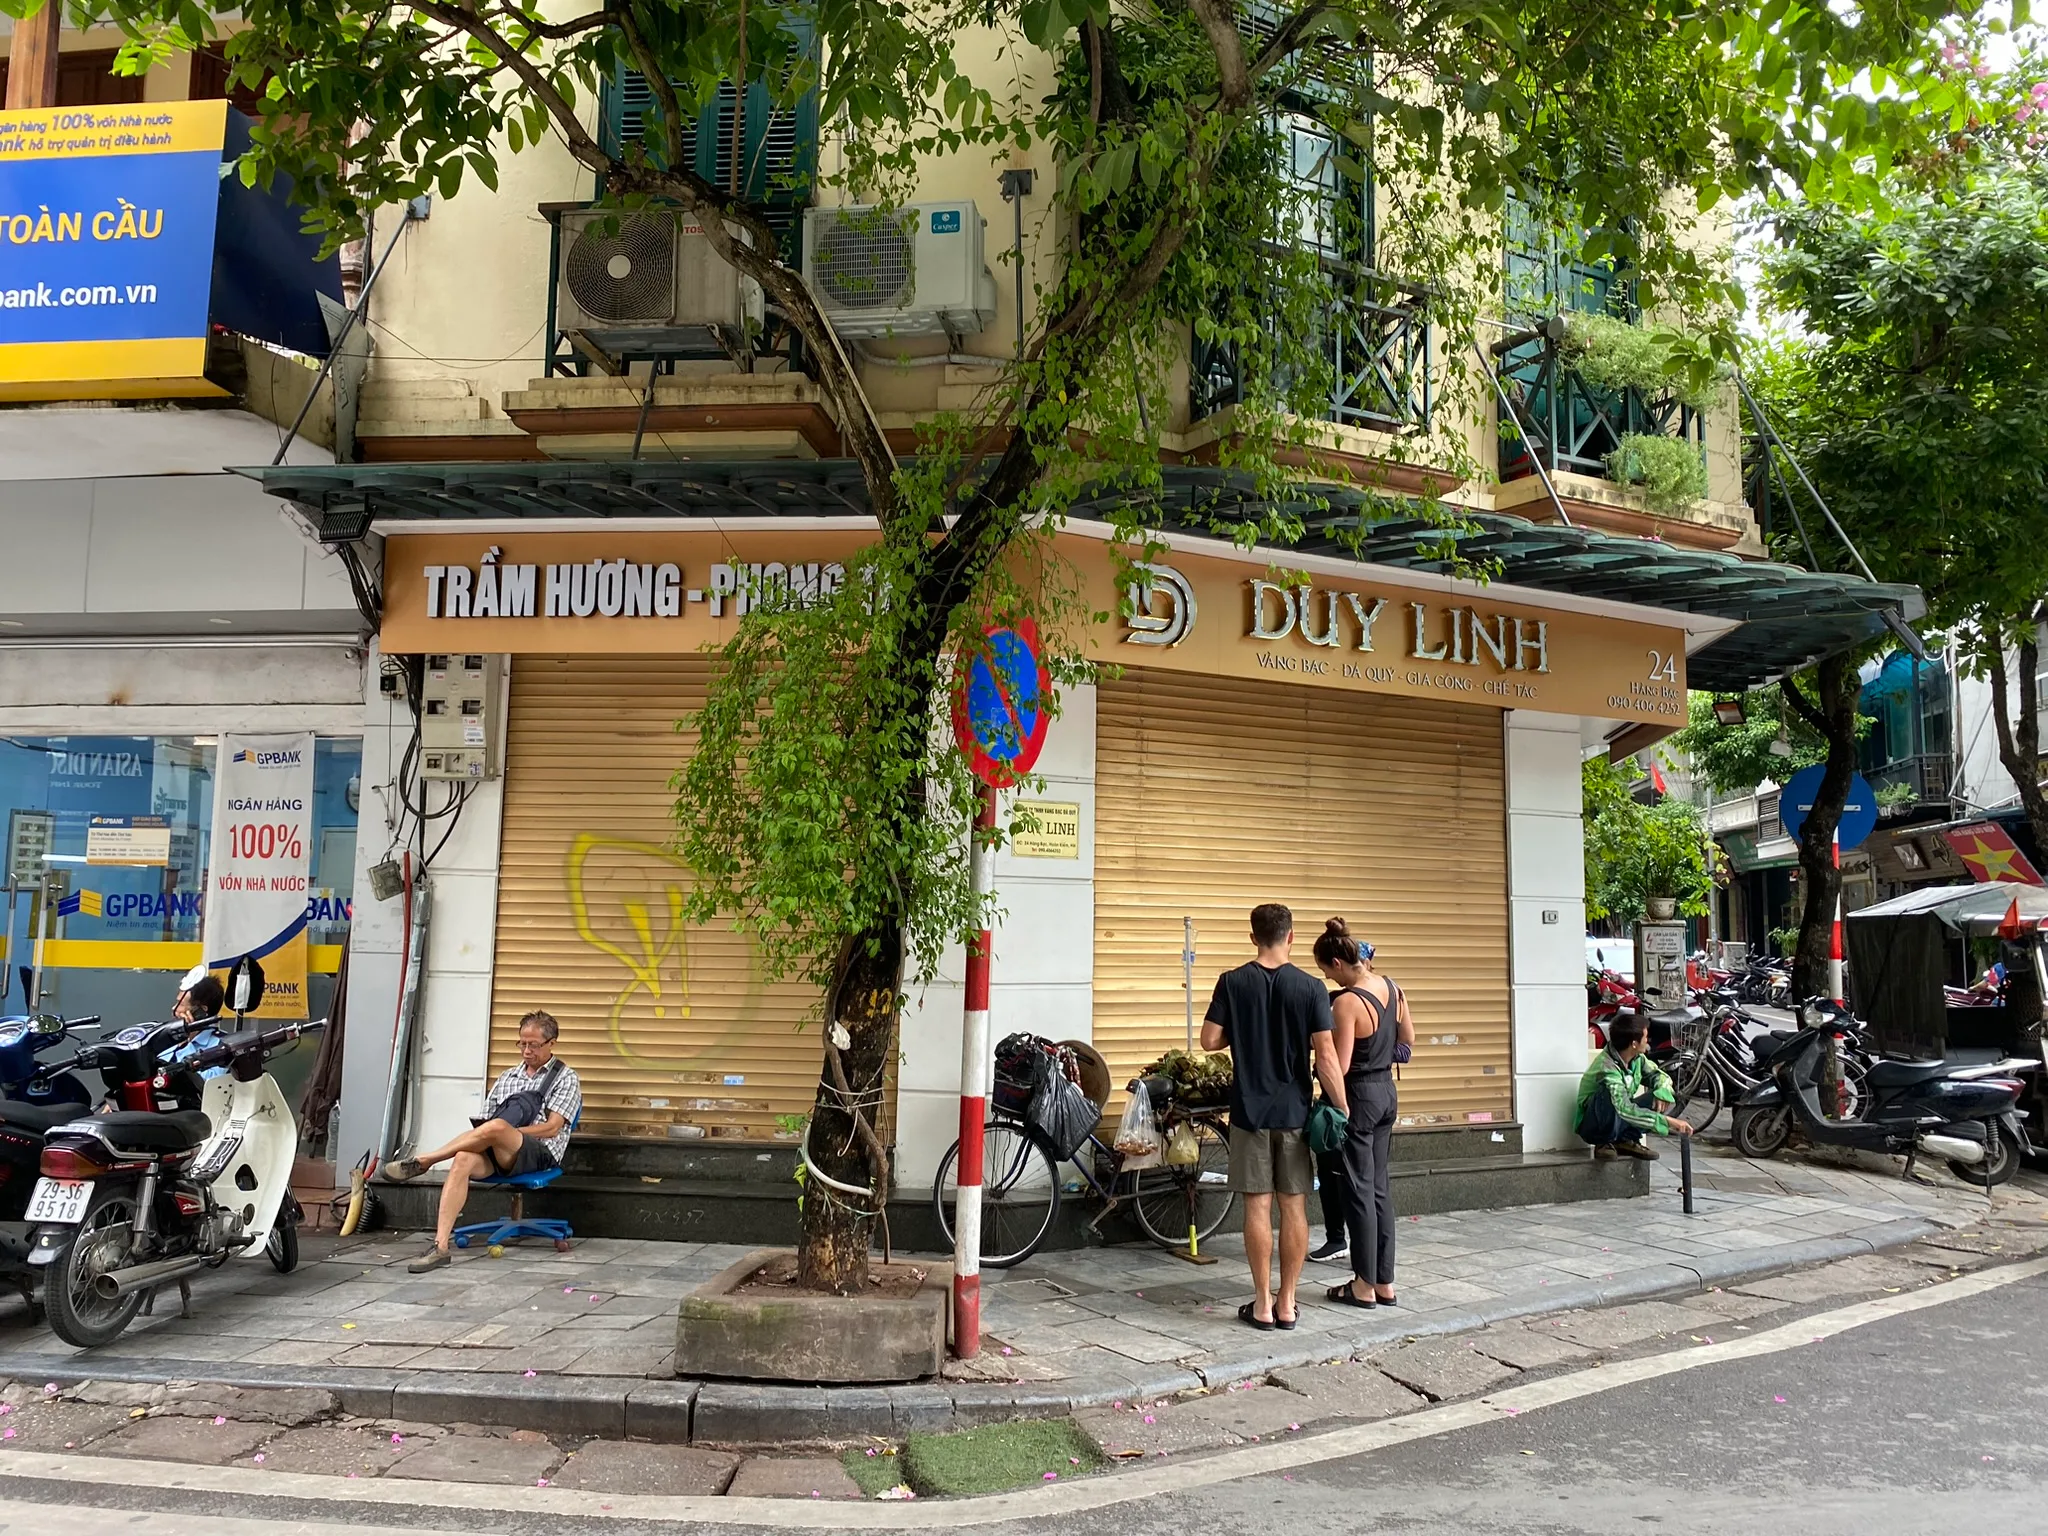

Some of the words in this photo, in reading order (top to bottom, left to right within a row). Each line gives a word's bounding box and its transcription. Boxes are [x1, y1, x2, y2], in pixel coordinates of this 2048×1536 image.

[19, 120, 48, 134] hàng
[52, 113, 95, 131] 100%
[96, 116, 116, 128] vốn
[118, 114, 142, 127] Nhà
[144, 113, 173, 126] nước
[0, 134, 26, 152] nk
[99, 134, 113, 149] trị
[142, 131, 172, 145] hành
[0, 204, 83, 244] TOÀN
[91, 196, 165, 241] CẦU
[423, 545, 539, 618] TRẦM
[544, 557, 683, 618] HƯƠNG
[1248, 577, 1389, 653] DUY
[1410, 600, 1552, 674] LINH
[1255, 651, 1297, 672] VÀNG
[1301, 658, 1330, 677] BẠC
[1342, 661, 1361, 680] ĐÁ
[1364, 665, 1395, 684] QUÝ
[1406, 671, 1432, 688] GIA
[1434, 673, 1473, 692] CÔNG
[1483, 678, 1510, 696] CHẾ
[1512, 679, 1539, 699] TÁC
[1646, 650, 1679, 683] 24
[1607, 694, 1632, 710] 090
[1633, 698, 1656, 713] 406
[1656, 700, 1681, 716] 4252
[257, 750, 302, 765] GPBANK
[228, 796, 262, 811] NGÂN
[265, 796, 303, 811] HÀNG
[1046, 821, 1076, 836] LINH
[229, 823, 301, 859] 100%
[218, 872, 242, 891] VỐN
[246, 875, 266, 891] NHÀ
[271, 874, 305, 891] NƯỚC
[105, 892, 202, 918] GPBANK
[41, 1181, 85, 1201] 29-S6
[33, 1200, 79, 1219] 9518
